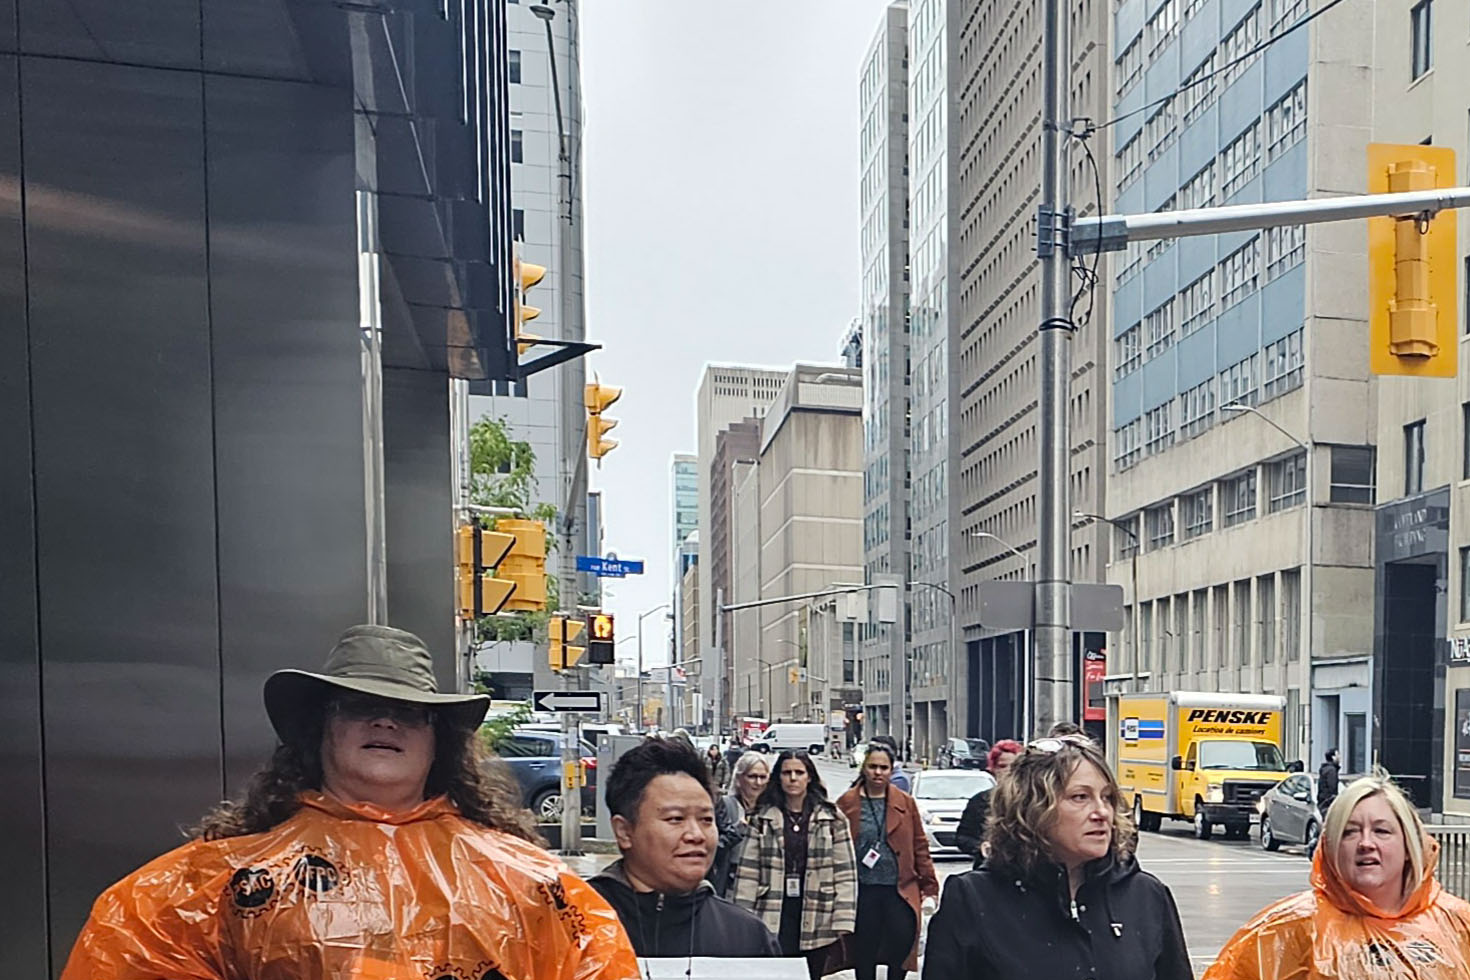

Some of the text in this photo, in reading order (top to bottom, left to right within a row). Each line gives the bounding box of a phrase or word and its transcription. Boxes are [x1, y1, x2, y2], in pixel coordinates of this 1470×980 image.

[602, 561, 622, 572] Kent
[1187, 710, 1272, 724] PENSKE
[1193, 725, 1224, 733] Location
[233, 873, 272, 896] SAC
